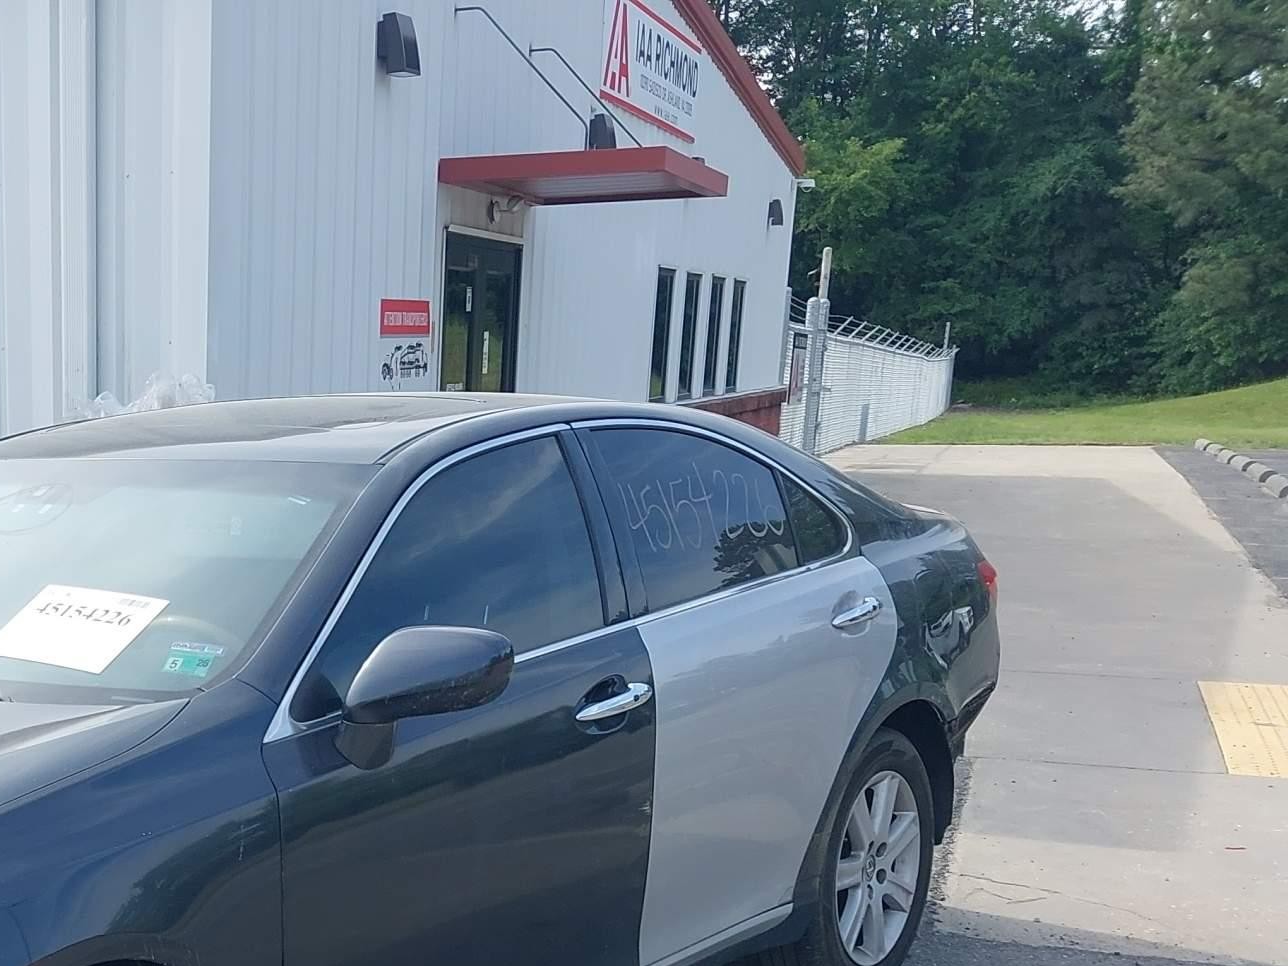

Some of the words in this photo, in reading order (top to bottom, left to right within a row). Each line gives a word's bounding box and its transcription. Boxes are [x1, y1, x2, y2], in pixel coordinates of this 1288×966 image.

[635, 20, 652, 71] IAA
[654, 34, 699, 98] RICHMOND
[617, 461, 784, 553] 45154226
[36, 601, 132, 627] 45154226
